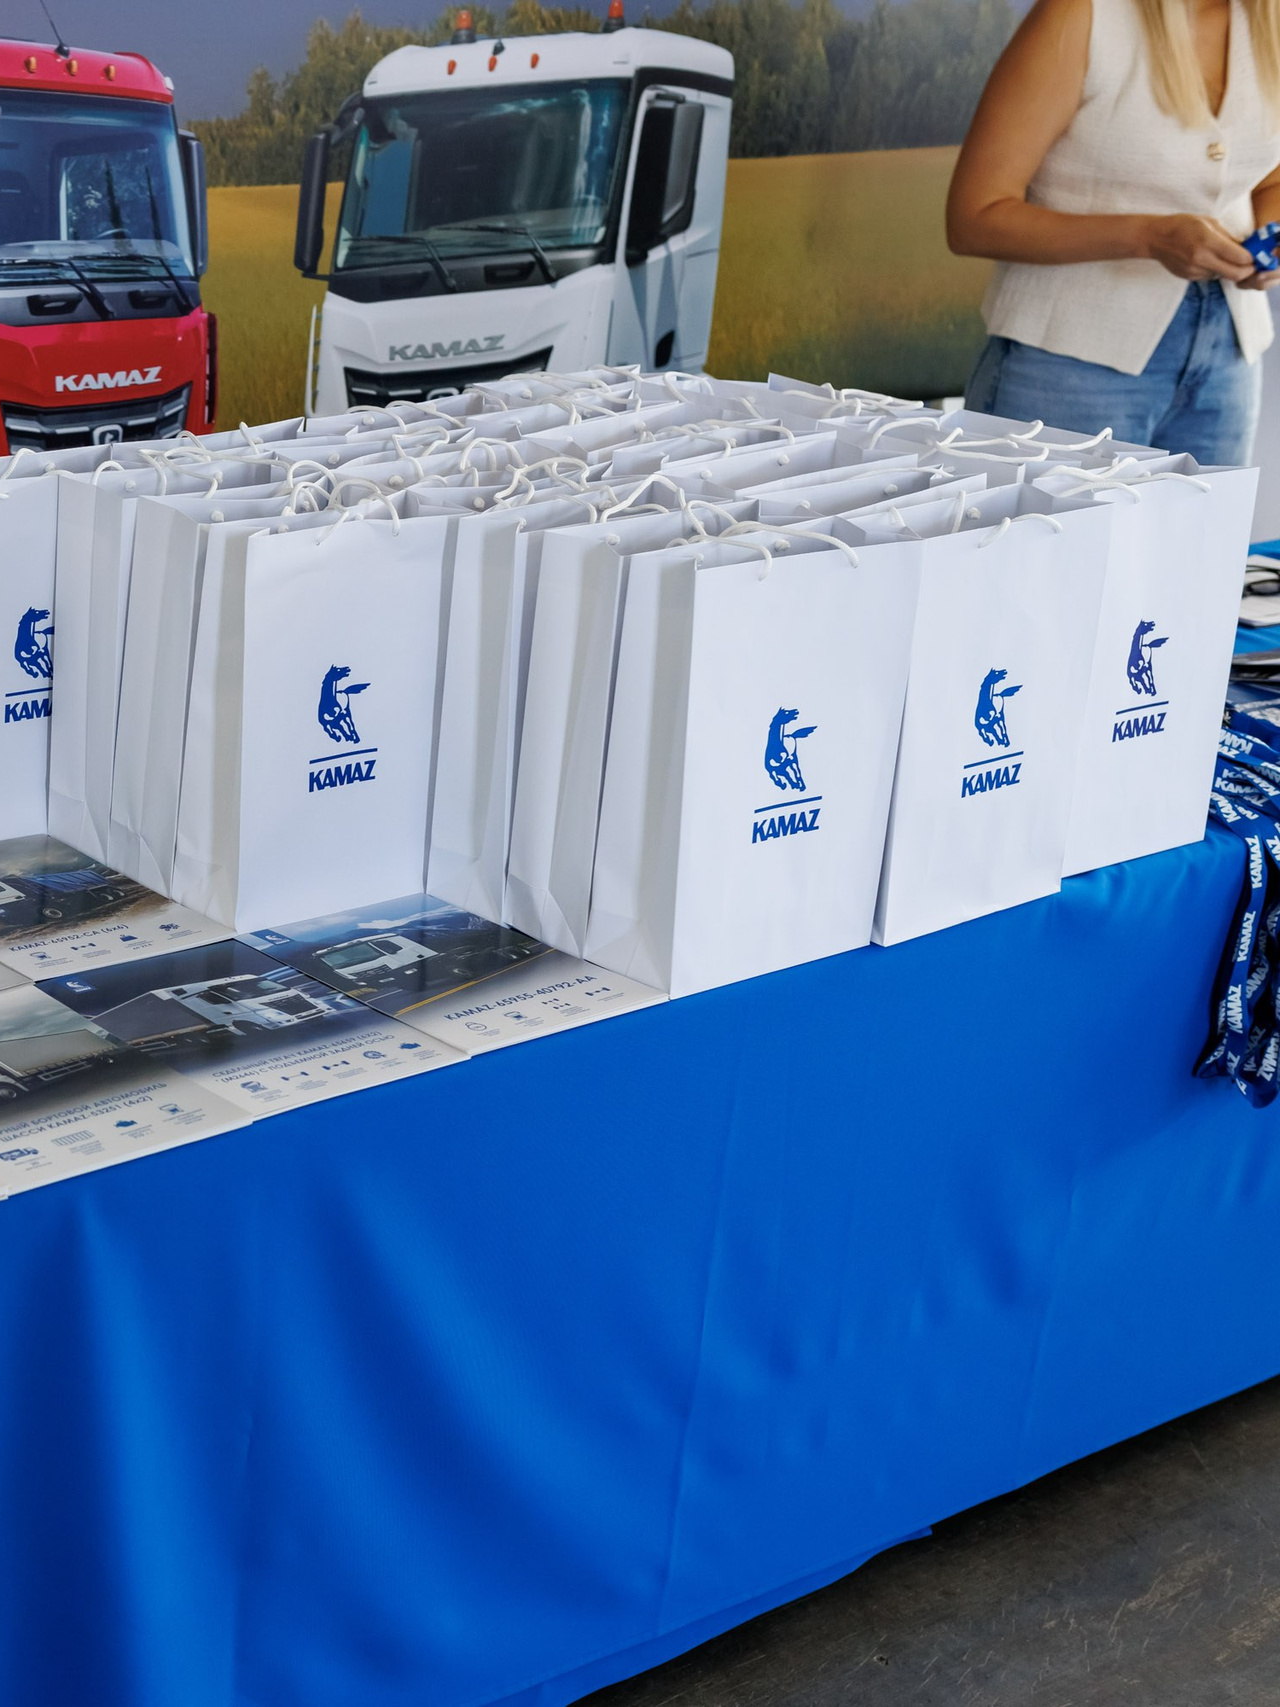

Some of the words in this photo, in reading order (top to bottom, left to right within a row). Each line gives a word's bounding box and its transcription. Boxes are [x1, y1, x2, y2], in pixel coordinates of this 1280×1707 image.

[387, 333, 507, 362] KAMAZ
[55, 366, 163, 393] KAMAZ
[5, 697, 53, 724] KAM
[1112, 711, 1167, 743] KAMAZ
[308, 760, 377, 793] KAMAZ
[961, 763, 1022, 798] KAMAZ
[752, 808, 821, 844] KAMAZ
[1245, 835, 1262, 889] KAMAZ
[1237, 911, 1256, 962] KAMAZ
[365, 1034, 396, 1045] ОСЬЮ
[31, 1103, 92, 1126] БОРТОВОЙ
[92, 1081, 168, 1111] АВТОМОБИЛЬ
[1, 1125, 47, 1143] ШАССИ
